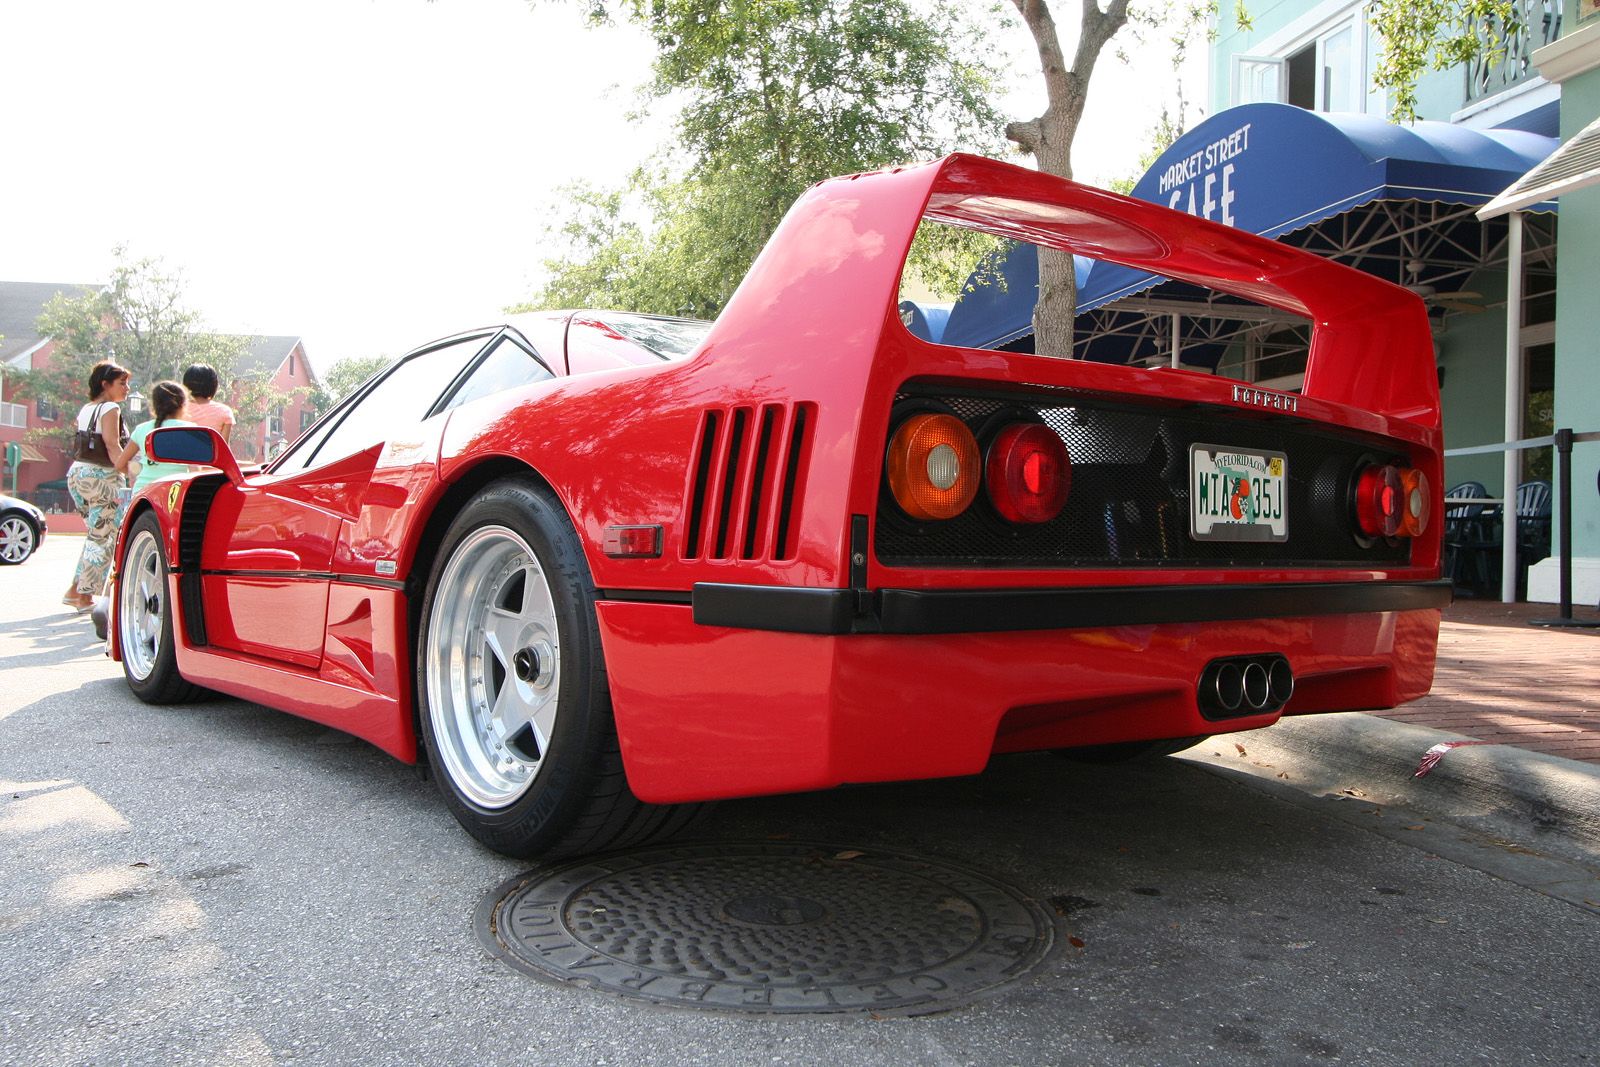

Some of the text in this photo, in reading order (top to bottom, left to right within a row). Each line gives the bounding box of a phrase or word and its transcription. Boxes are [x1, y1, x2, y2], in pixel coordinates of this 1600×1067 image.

[1159, 123, 1251, 195] MARKET STREET
[1233, 384, 1297, 412] Ferrari
[1199, 472, 1282, 519] MIA 35J
